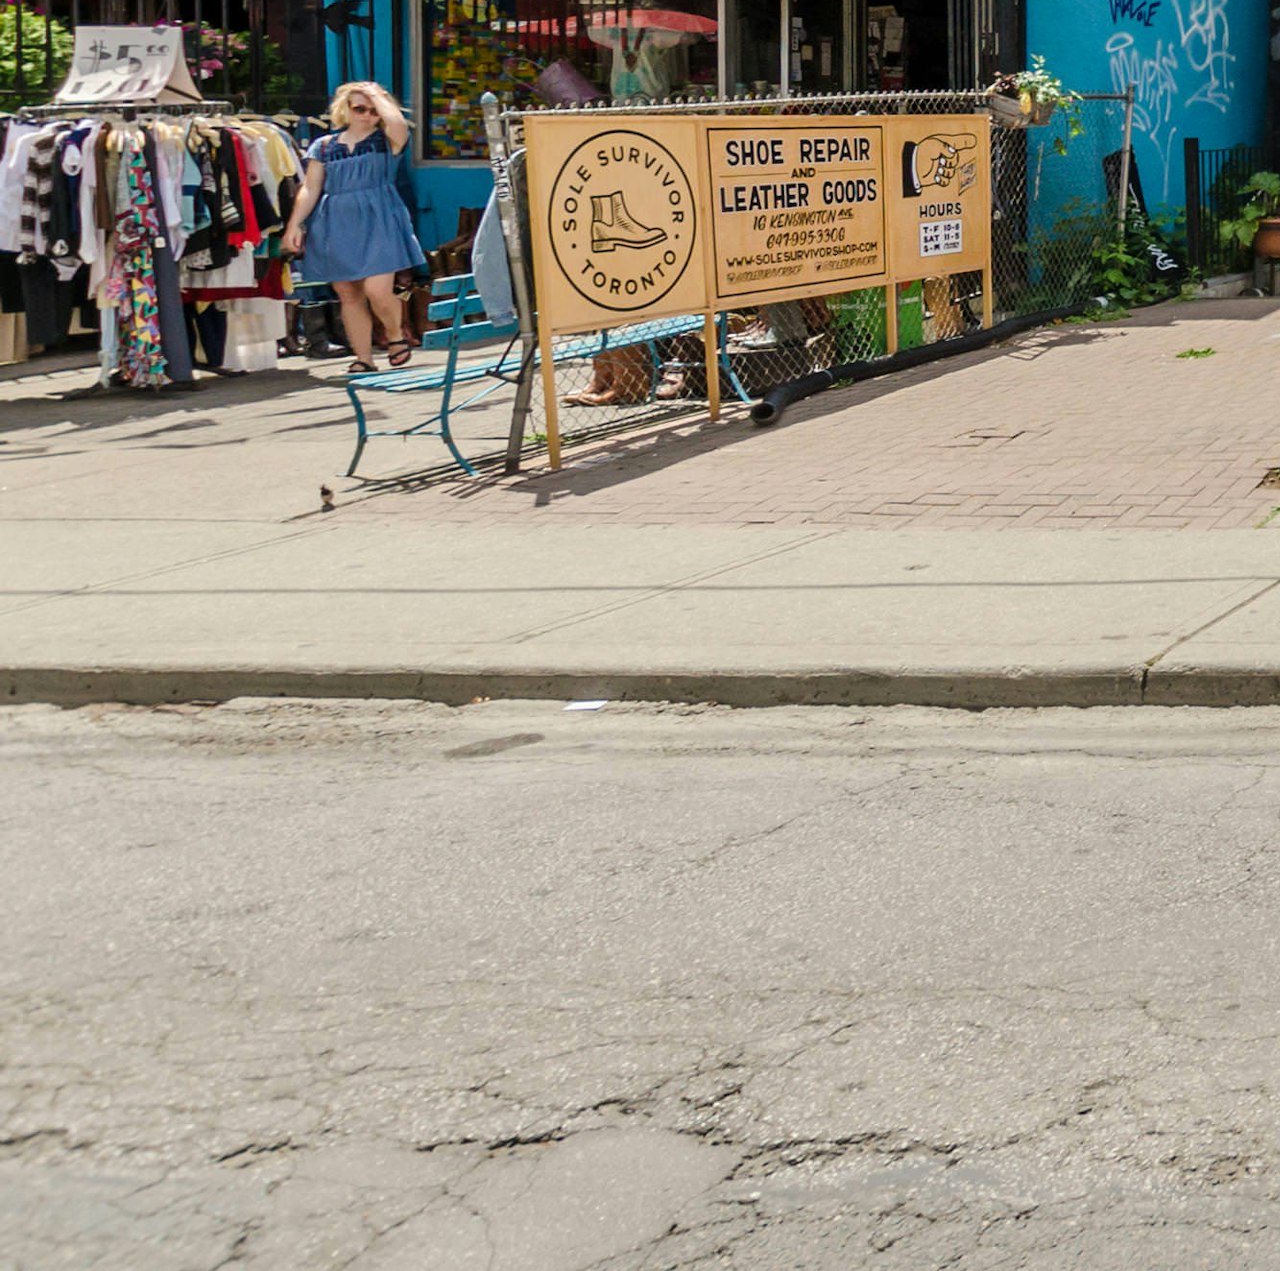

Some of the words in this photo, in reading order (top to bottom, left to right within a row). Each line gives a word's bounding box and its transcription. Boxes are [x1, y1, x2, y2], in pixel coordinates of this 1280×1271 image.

[726, 139, 784, 166] SHOE
[800, 138, 870, 163] REPAIR
[791, 168, 816, 178] AND
[563, 165, 592, 232] SOLE
[597, 146, 684, 223] SURVIVOR
[720, 183, 809, 213] LEATHER
[823, 179, 877, 205] GOODS
[769, 209, 837, 229] KENSINGTON
[919, 203, 962, 218] HOURS
[923, 234, 940, 244] SAT
[581, 250, 676, 295] TORONTO
